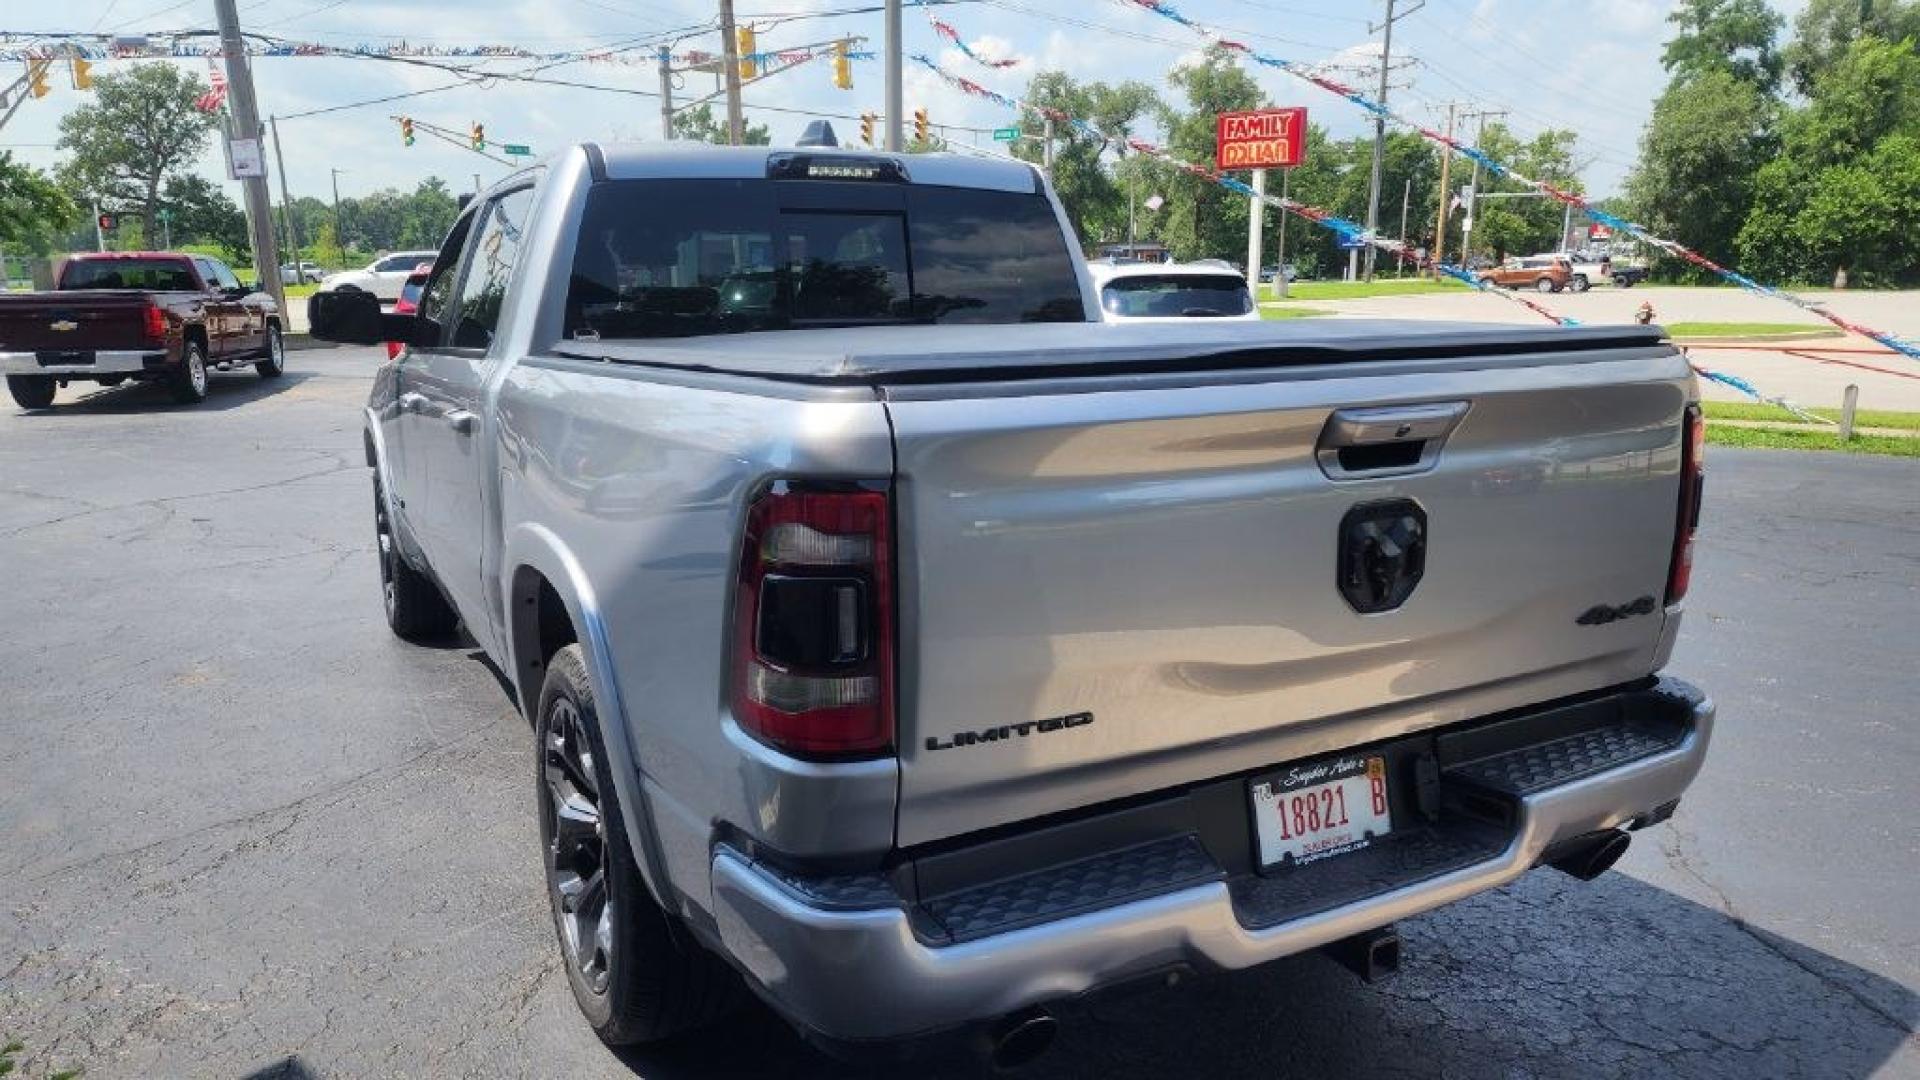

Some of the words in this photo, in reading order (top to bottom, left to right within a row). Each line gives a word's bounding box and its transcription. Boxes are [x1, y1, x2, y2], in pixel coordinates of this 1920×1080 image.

[1224, 111, 1294, 139] FAMILY
[1222, 138, 1289, 166] DOLLAR
[926, 711, 1094, 749] LIMITED
[1277, 785, 1349, 840] 18821
[1371, 777, 1386, 816] B
